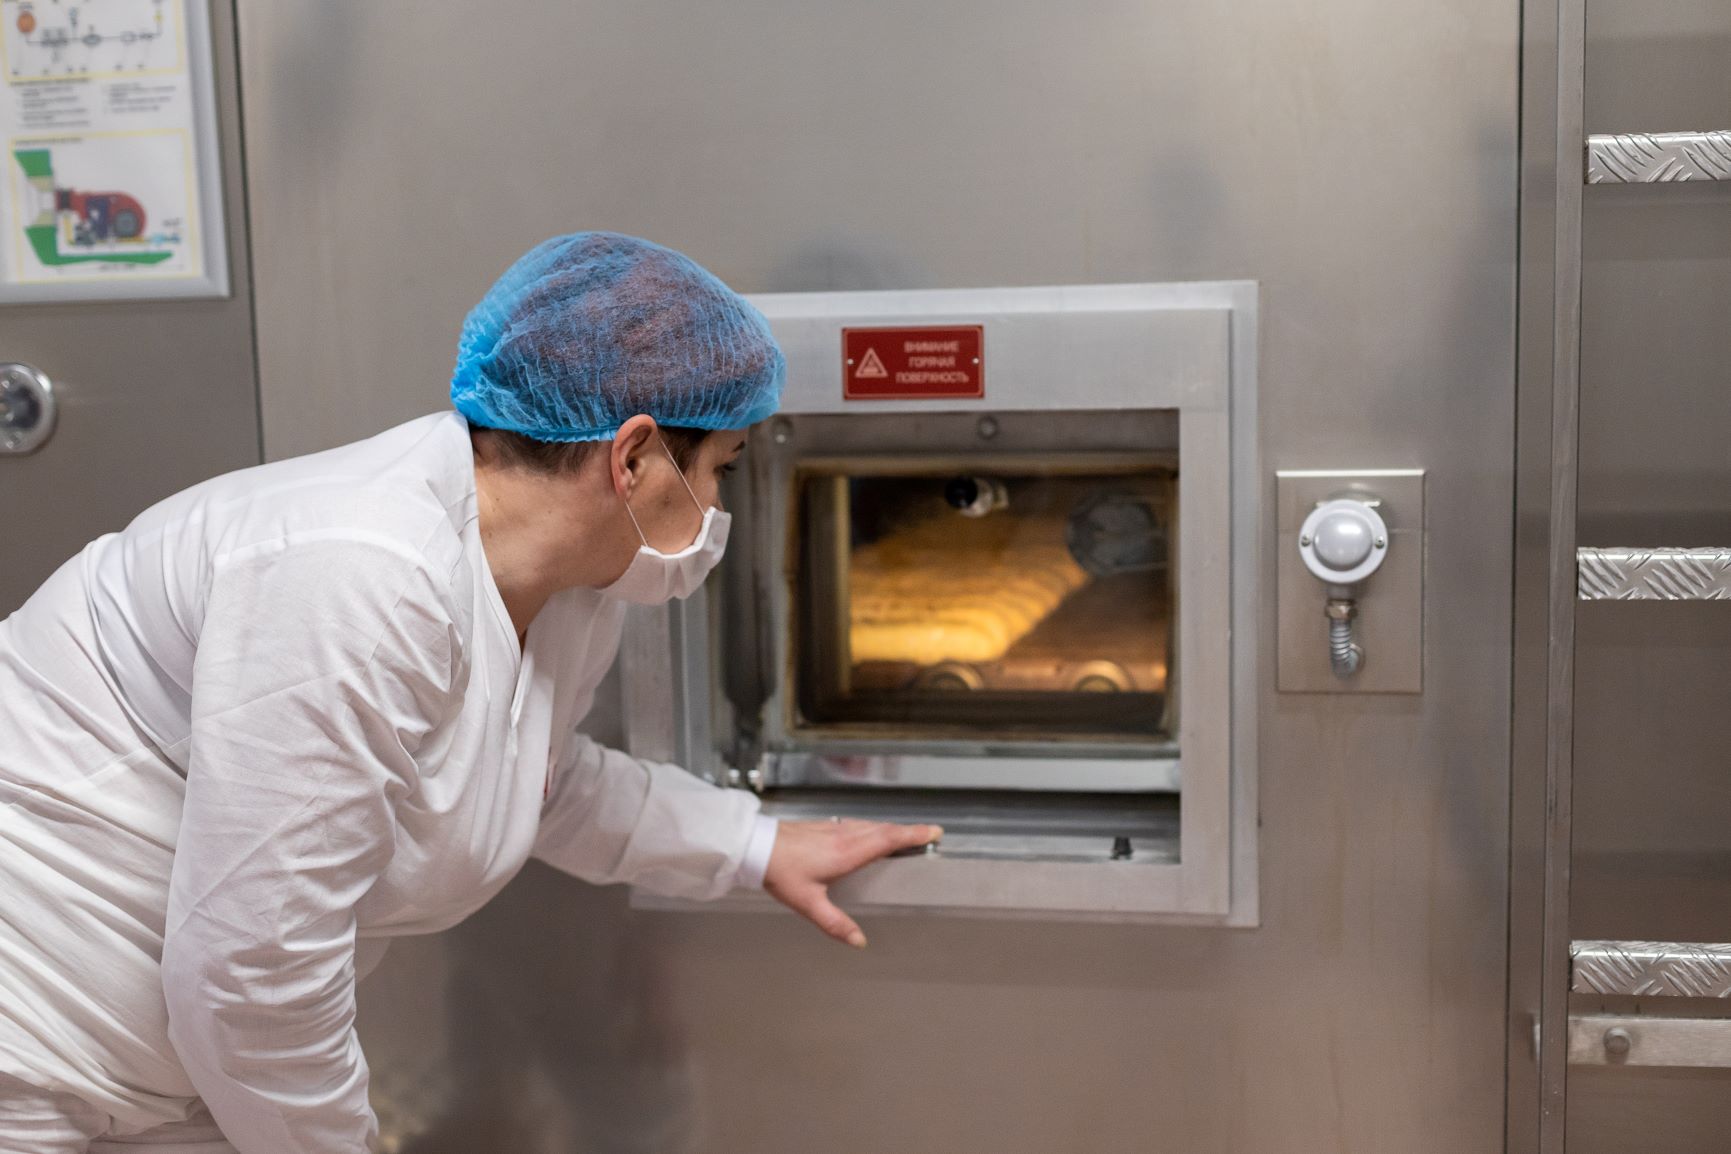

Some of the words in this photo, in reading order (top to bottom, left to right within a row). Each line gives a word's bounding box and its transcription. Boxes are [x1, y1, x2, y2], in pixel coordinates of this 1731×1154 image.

[904, 341, 959, 353] ВНИМАНИЕ
[908, 356, 956, 368] ГОРЯЧАЯ
[895, 371, 969, 383] ПОВЕРХНОСТЬ
